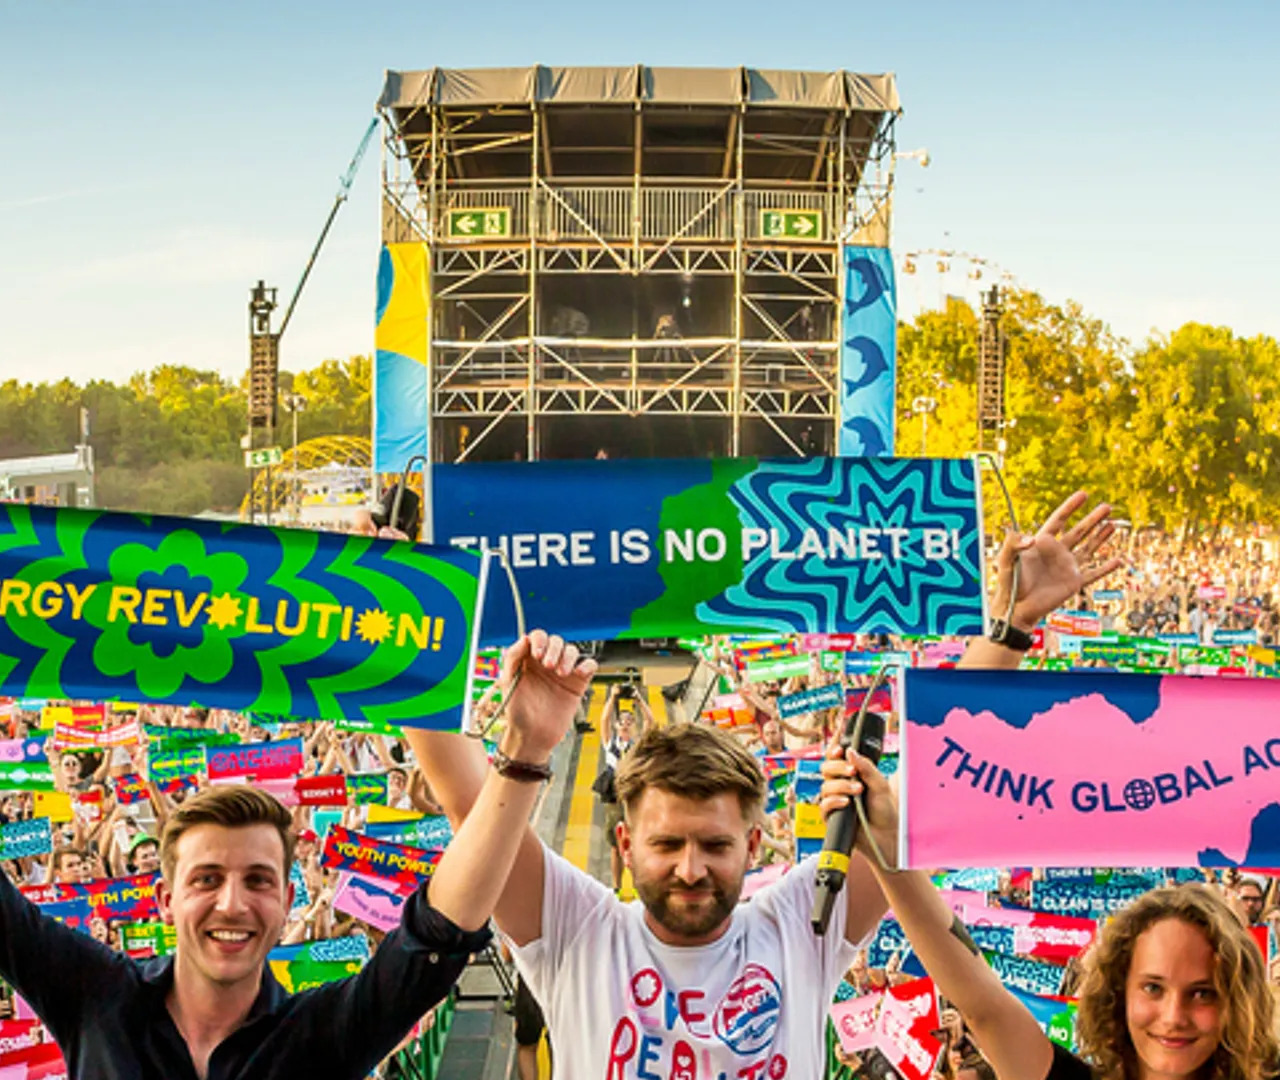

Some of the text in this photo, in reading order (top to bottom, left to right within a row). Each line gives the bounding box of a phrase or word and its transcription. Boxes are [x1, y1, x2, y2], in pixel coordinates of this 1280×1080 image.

[610, 529, 651, 564] IS
[663, 527, 728, 563] NO
[740, 525, 908, 562] PLANET
[922, 523, 961, 559] B!
[933, 737, 1057, 810] THINK
[1071, 760, 1234, 813] GLOBAL
[337, 840, 386, 864] YOUTH
